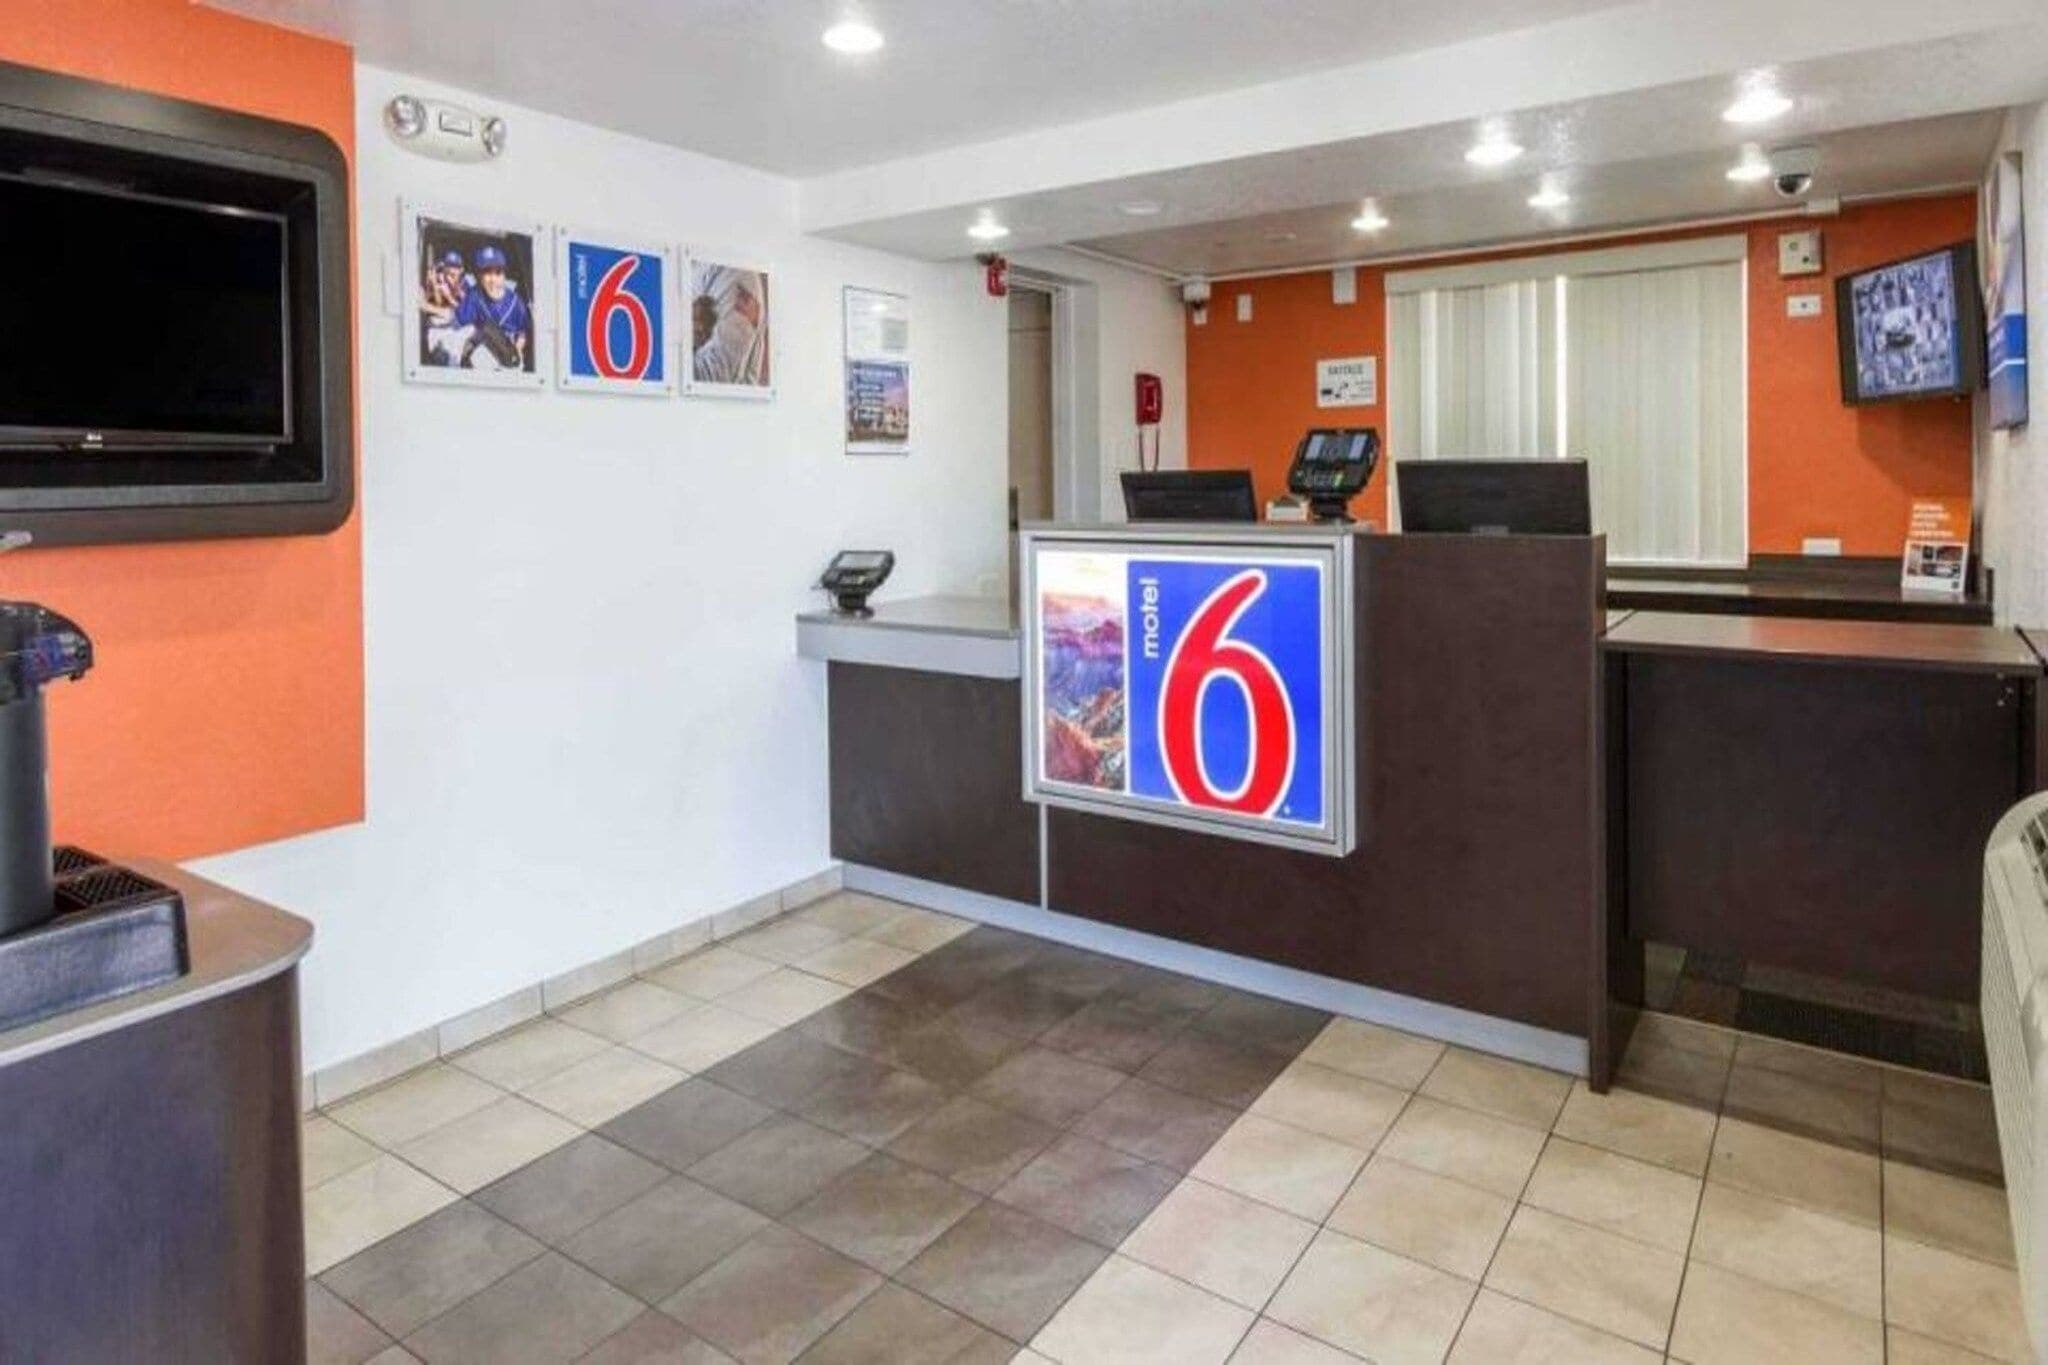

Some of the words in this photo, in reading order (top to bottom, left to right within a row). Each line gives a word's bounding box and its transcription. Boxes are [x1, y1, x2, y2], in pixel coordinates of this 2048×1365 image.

[586, 254, 652, 382] 6
[1139, 577, 1160, 659] motel
[1158, 568, 1297, 819] 6
